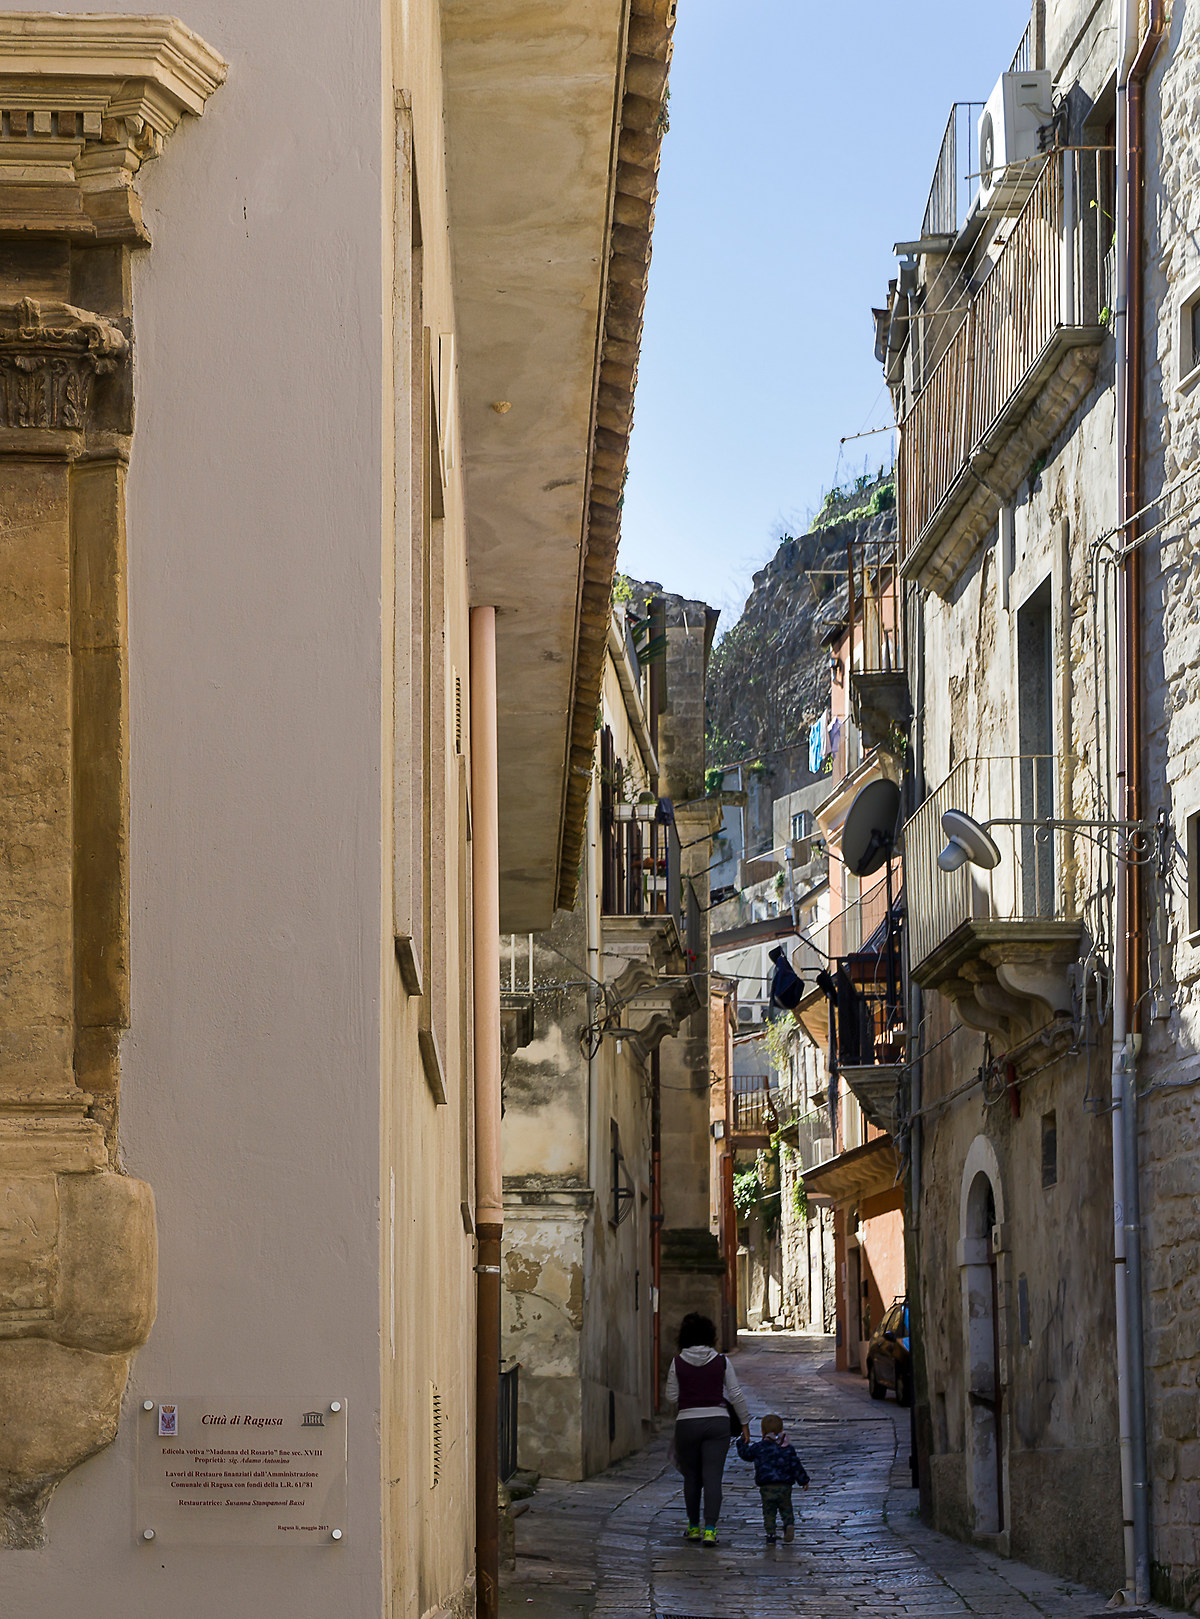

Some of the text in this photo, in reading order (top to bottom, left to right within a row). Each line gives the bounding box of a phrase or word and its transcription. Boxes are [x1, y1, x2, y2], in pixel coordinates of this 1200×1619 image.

[201, 1414, 284, 1428] Città di Ragusa
